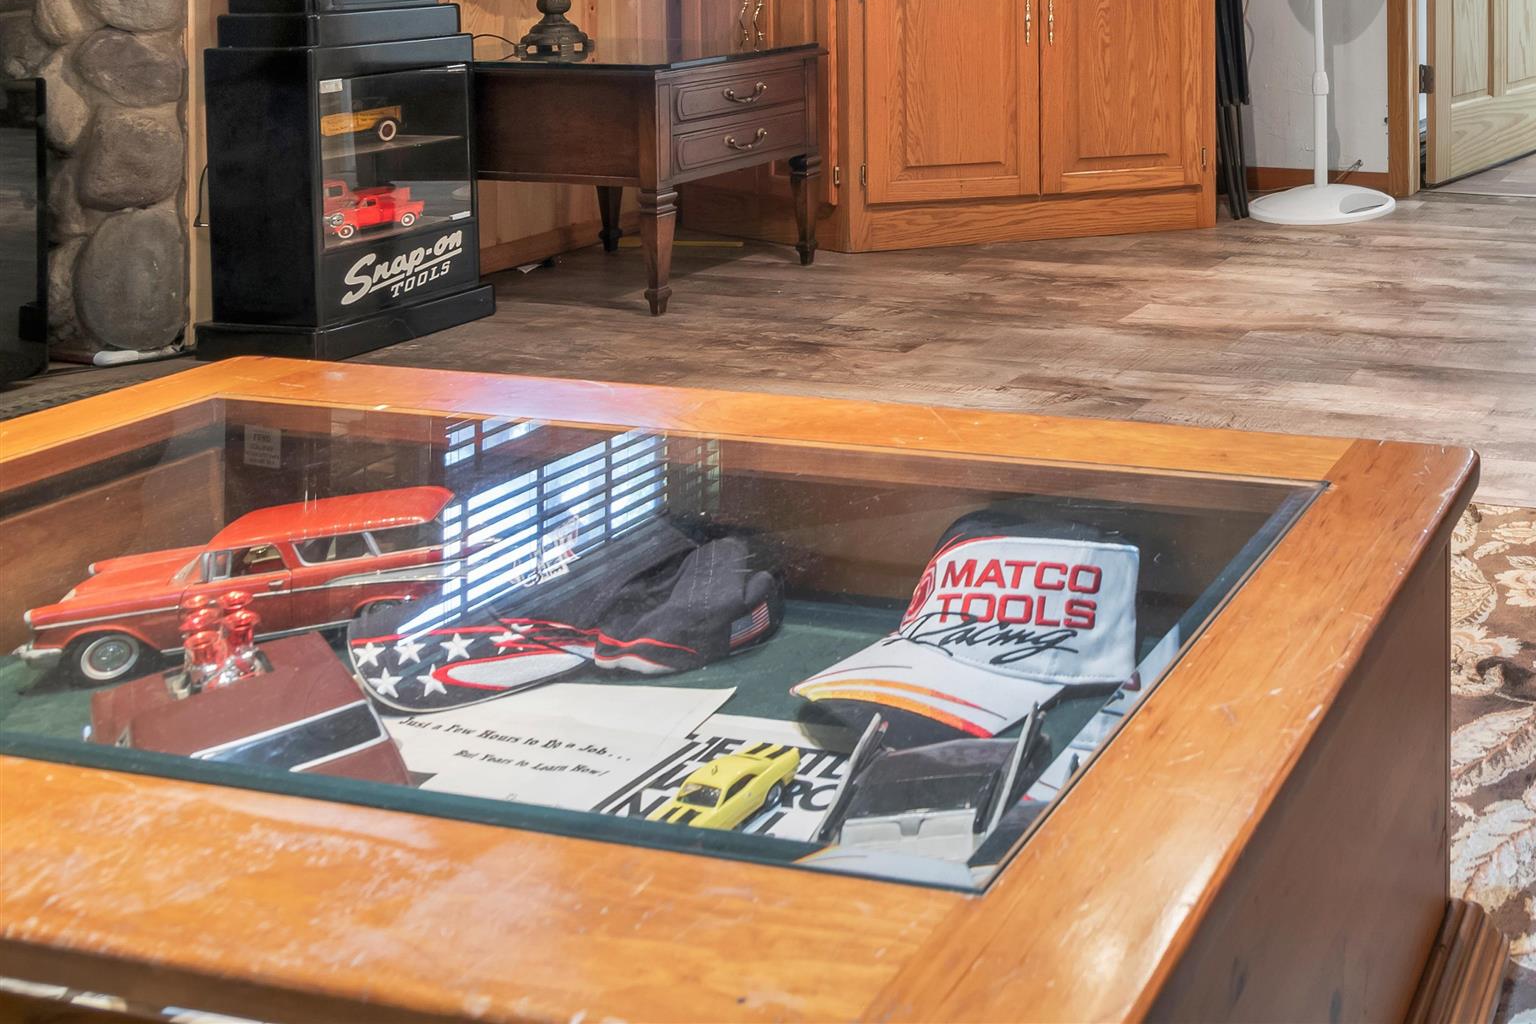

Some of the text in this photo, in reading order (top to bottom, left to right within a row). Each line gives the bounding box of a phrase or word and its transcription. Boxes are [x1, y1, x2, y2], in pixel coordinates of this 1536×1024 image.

[341, 230, 463, 305] Snap-on
[391, 260, 451, 298] TOOLS
[940, 559, 1102, 594] MATCO
[937, 592, 1098, 630] TOOLS
[882, 612, 1079, 665] Racing
[398, 716, 432, 729] Just
[443, 724, 477, 735] Few
[476, 729, 520, 743] Hours
[523, 737, 540, 746] to
[541, 739, 562, 750] Do
[453, 749, 480, 759] But
[479, 753, 514, 765] Years
[514, 759, 529, 767] to
[531, 763, 569, 773] Learn
